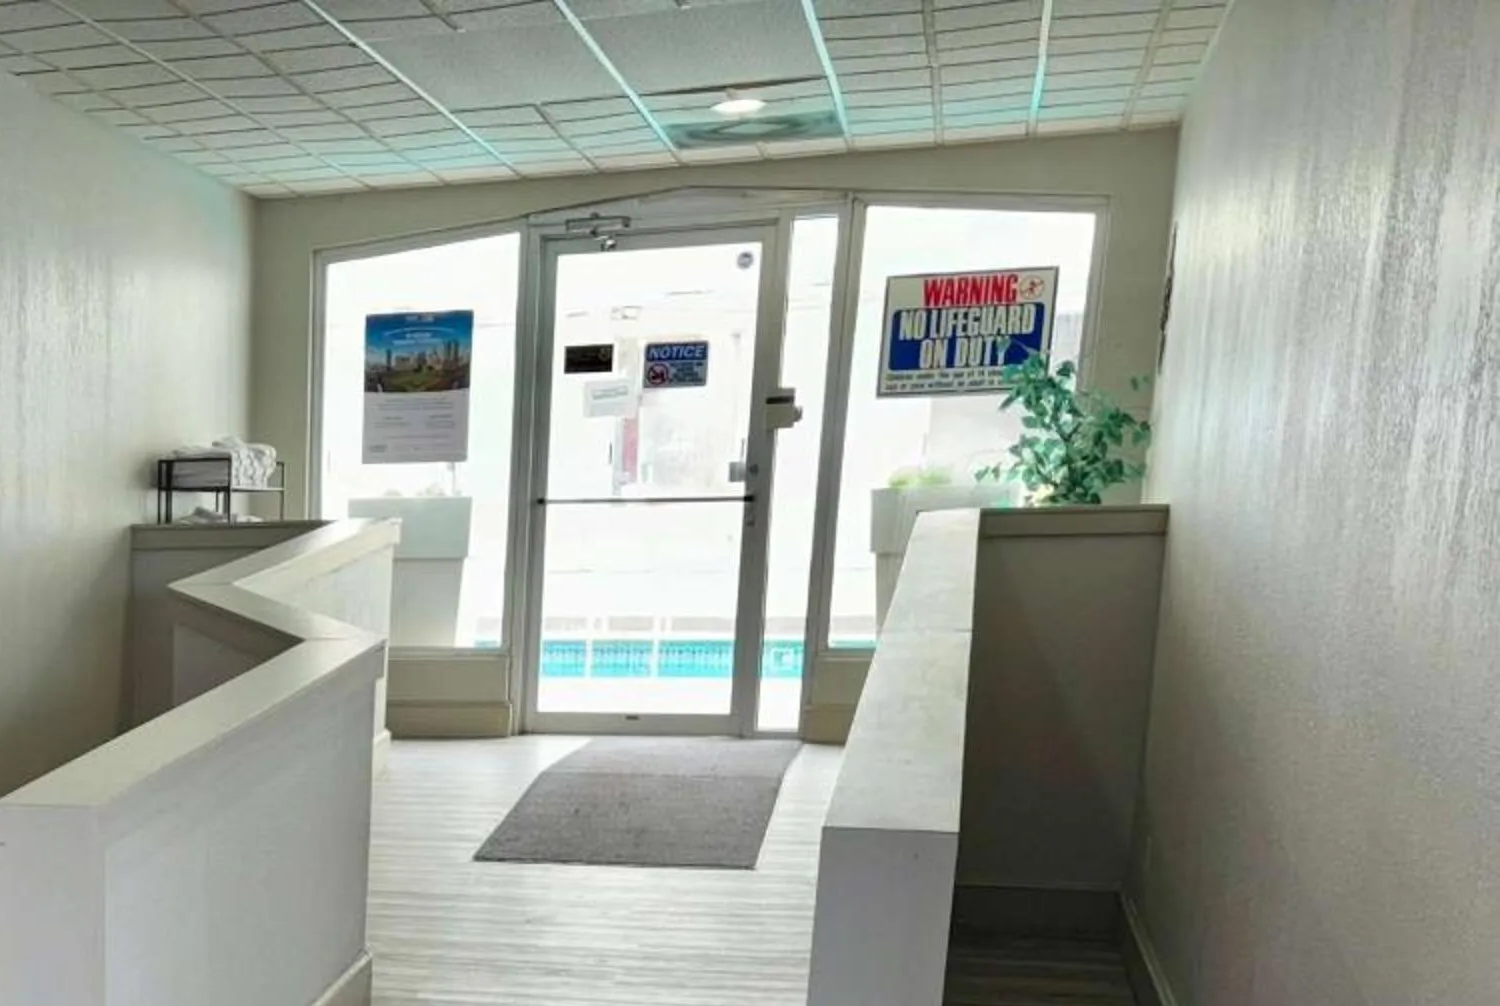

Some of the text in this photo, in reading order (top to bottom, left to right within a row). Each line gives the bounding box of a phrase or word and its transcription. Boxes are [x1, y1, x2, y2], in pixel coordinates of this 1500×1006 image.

[924, 274, 1018, 307] WARNING
[899, 303, 1036, 341] NO LIFEGUARD
[649, 345, 705, 360] NOTICE
[919, 338, 949, 369] ON
